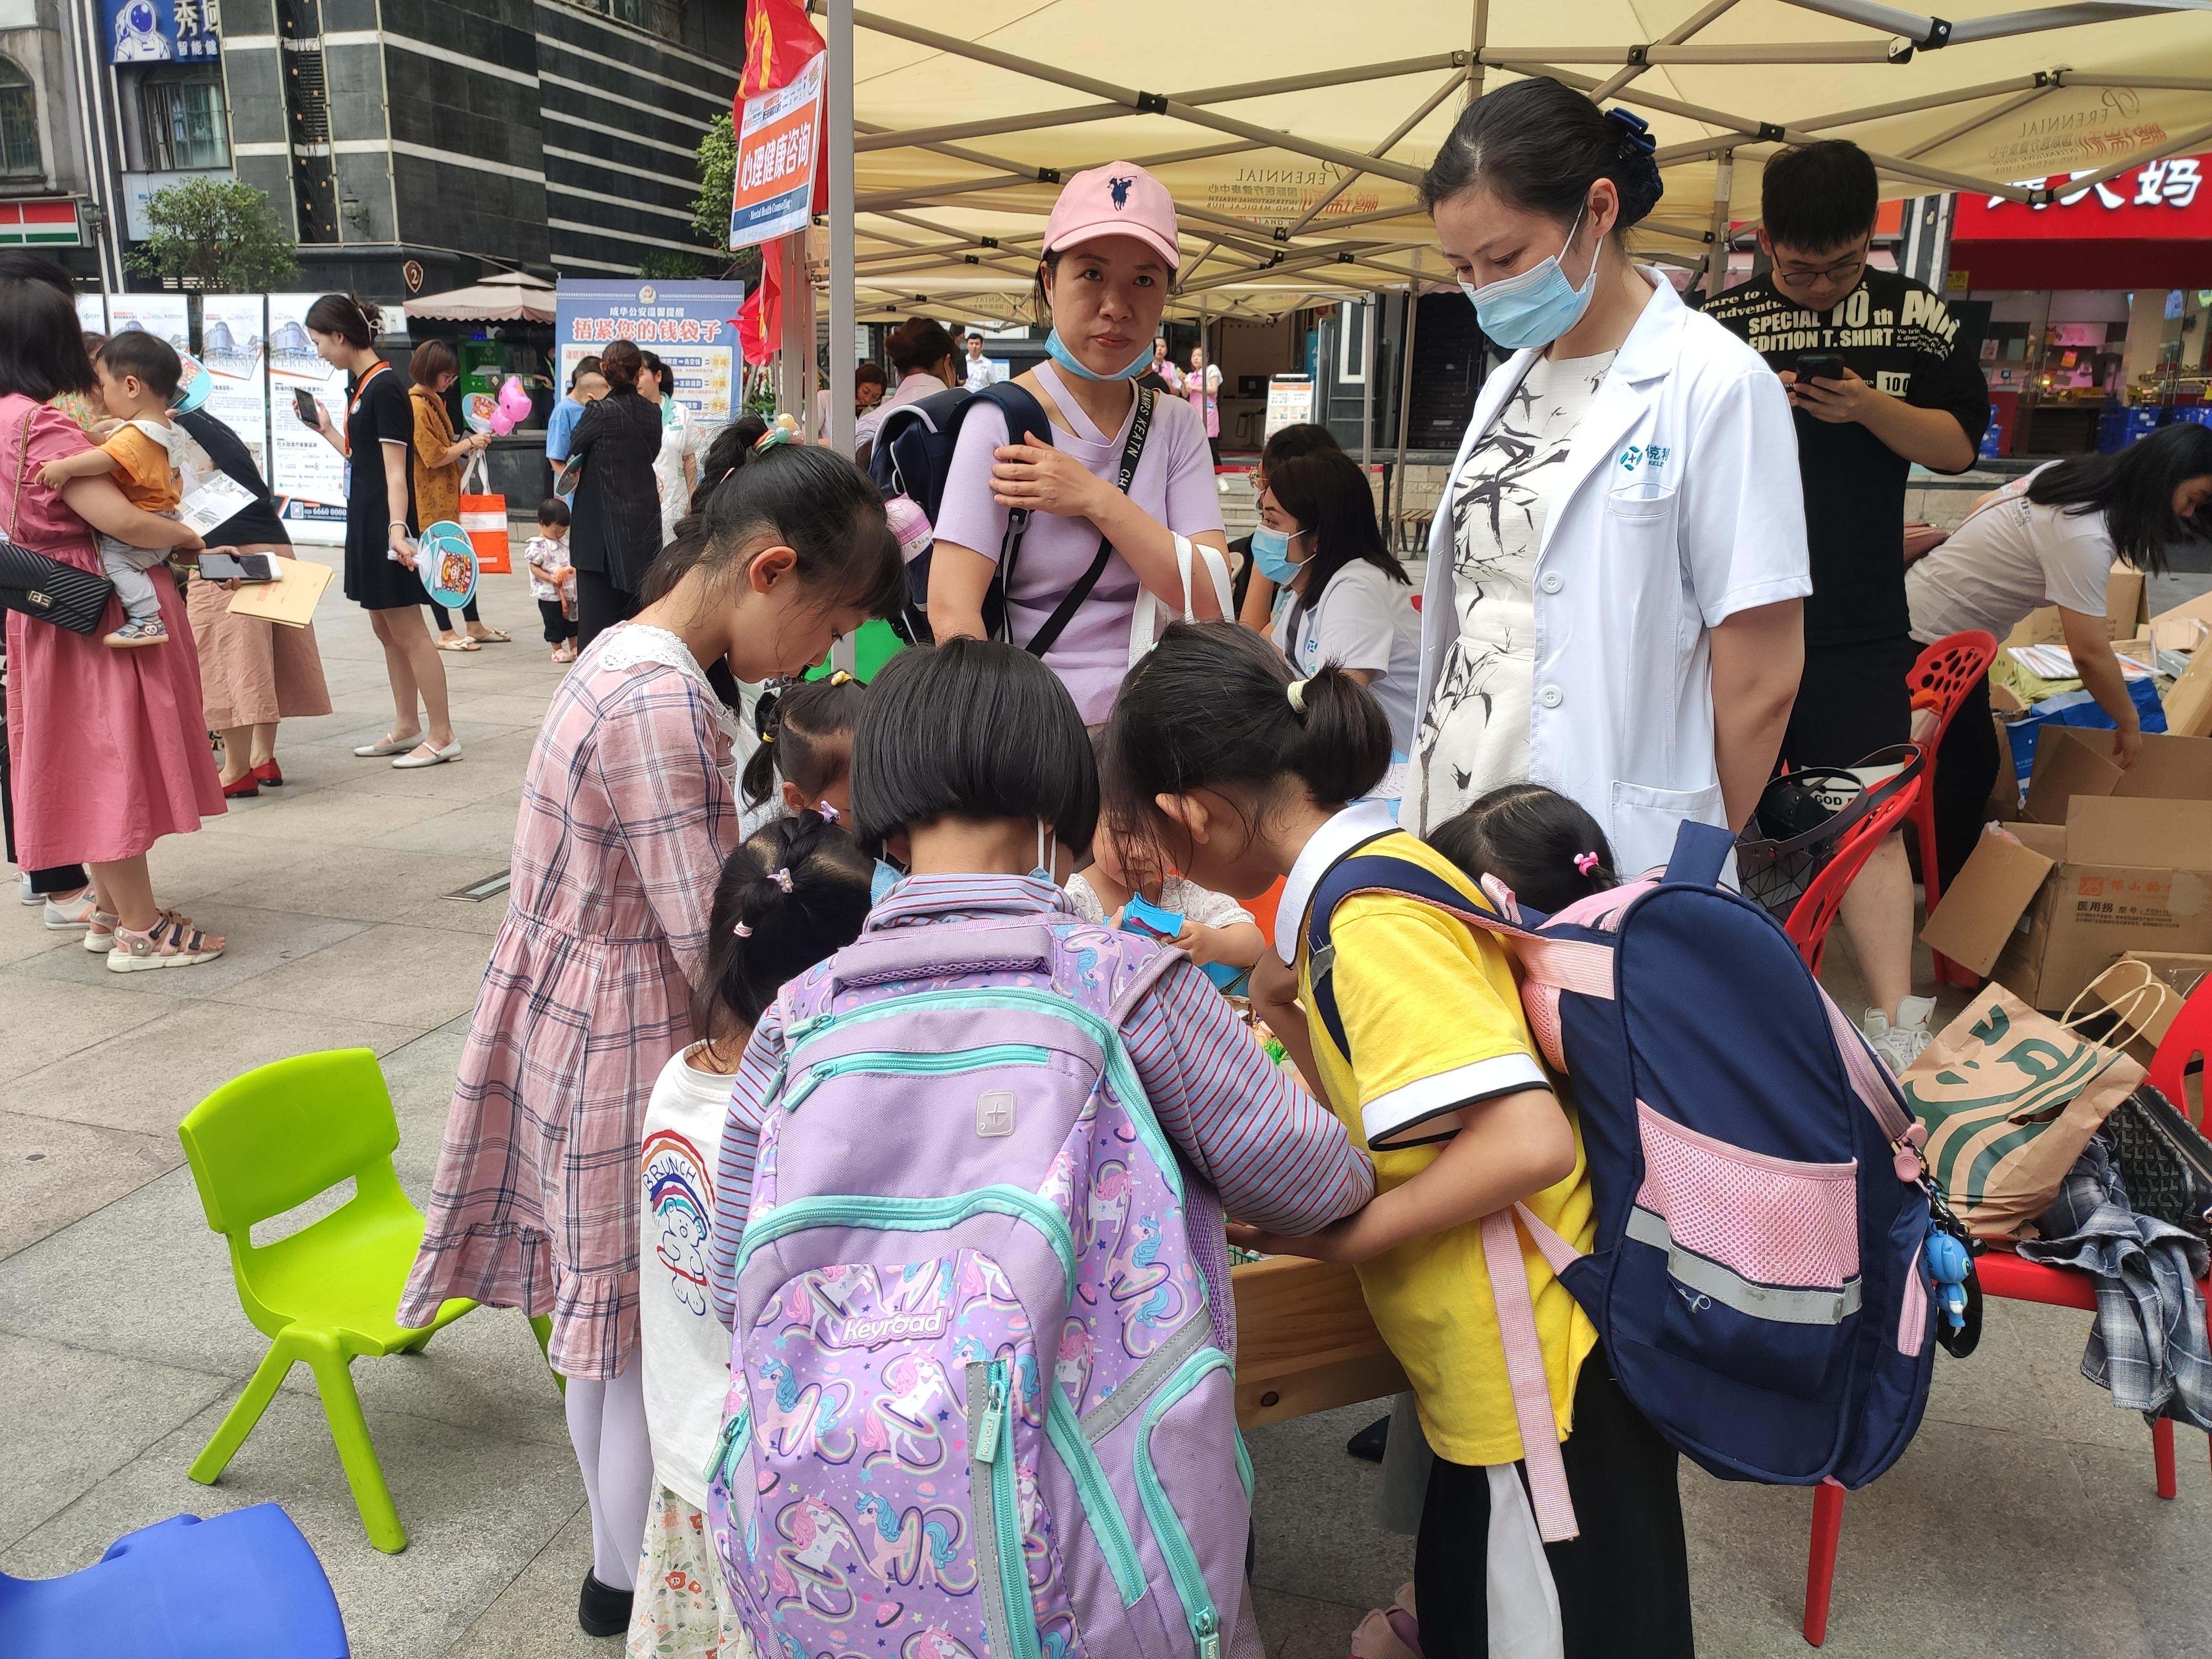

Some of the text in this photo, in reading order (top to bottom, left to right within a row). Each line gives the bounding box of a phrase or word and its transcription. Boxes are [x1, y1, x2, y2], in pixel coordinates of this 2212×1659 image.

[740, 122, 811, 191] 心理健康咨询
[411, 268, 418, 284] 2
[1744, 291, 1760, 301] to
[610, 306, 685, 317] 成华公安温馨提醒
[1749, 310, 1821, 335] SPECIAL
[1873, 308, 1893, 326] th
[572, 317, 722, 343] 捂紧您的钱袋子
[1749, 331, 1818, 353] EDITION
[1814, 795, 1842, 805] GOD
[2078, 901, 2114, 913] 医用拐
[643, 1156, 697, 1191] BRUNCH
[844, 1310, 942, 1342] Keyroad
